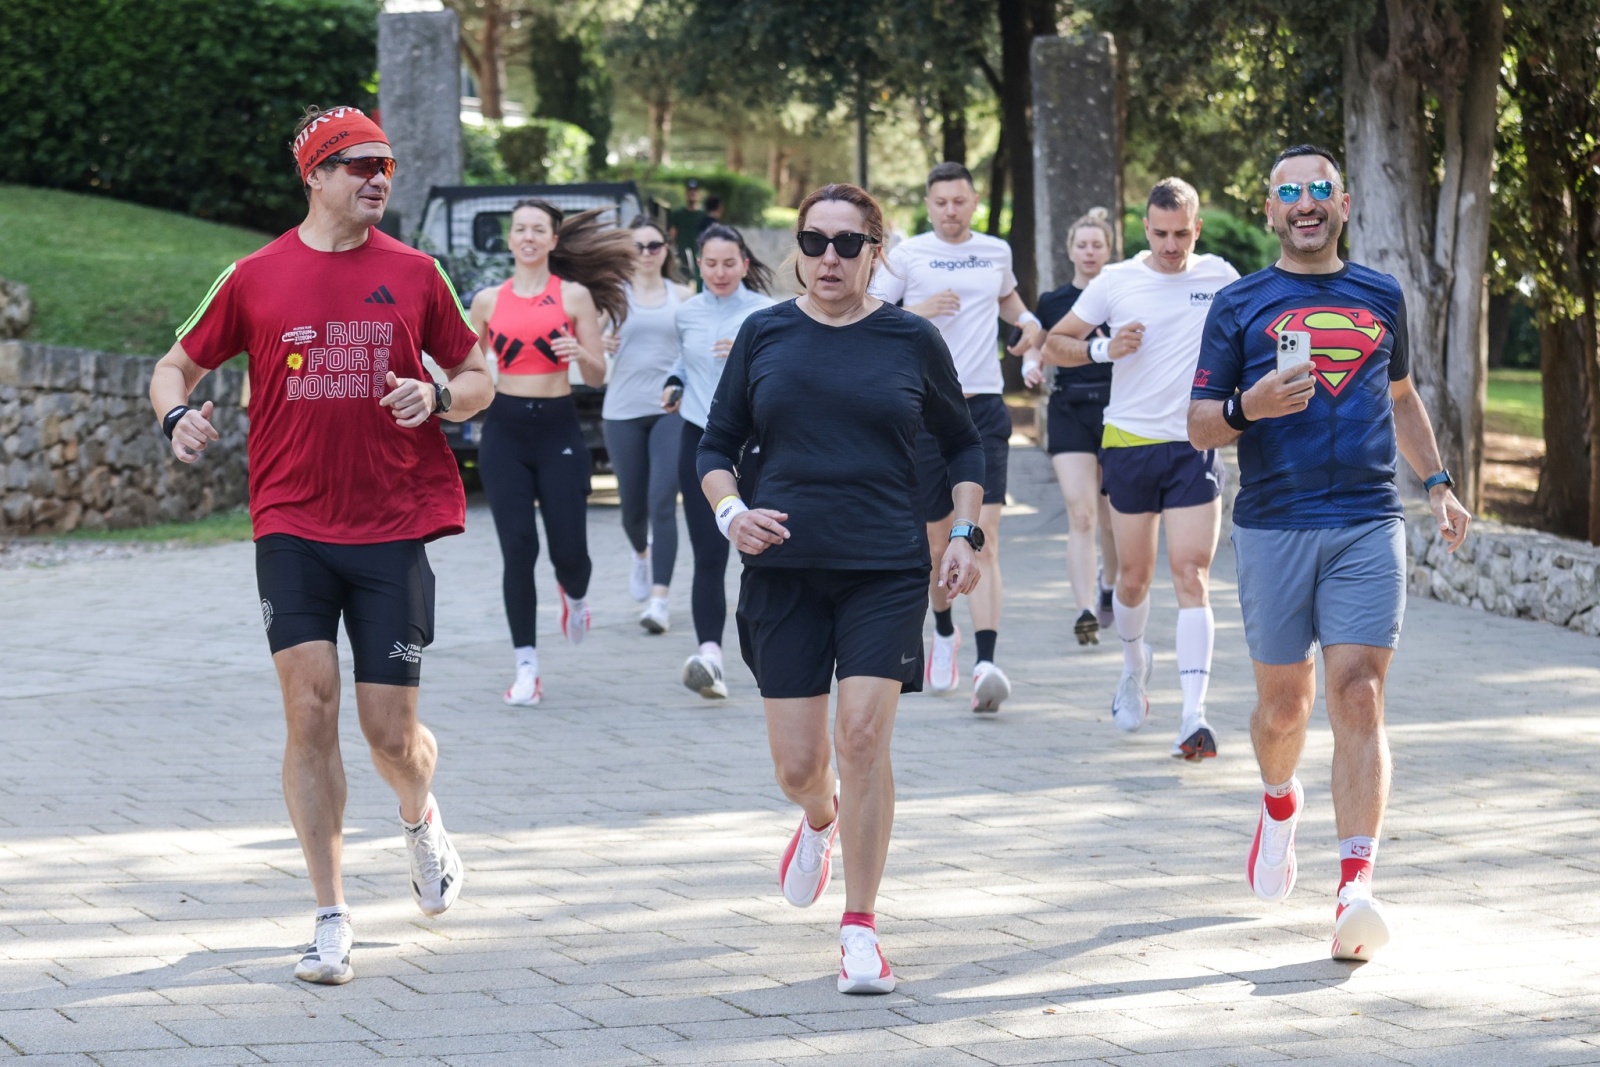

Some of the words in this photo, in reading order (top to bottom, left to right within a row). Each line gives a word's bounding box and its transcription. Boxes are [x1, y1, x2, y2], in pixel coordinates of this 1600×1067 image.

[929, 259, 993, 272] degordian
[326, 321, 393, 346] RUN
[308, 347, 370, 372] FOR
[373, 347, 390, 398] 2026
[286, 373, 370, 400] DOWN
